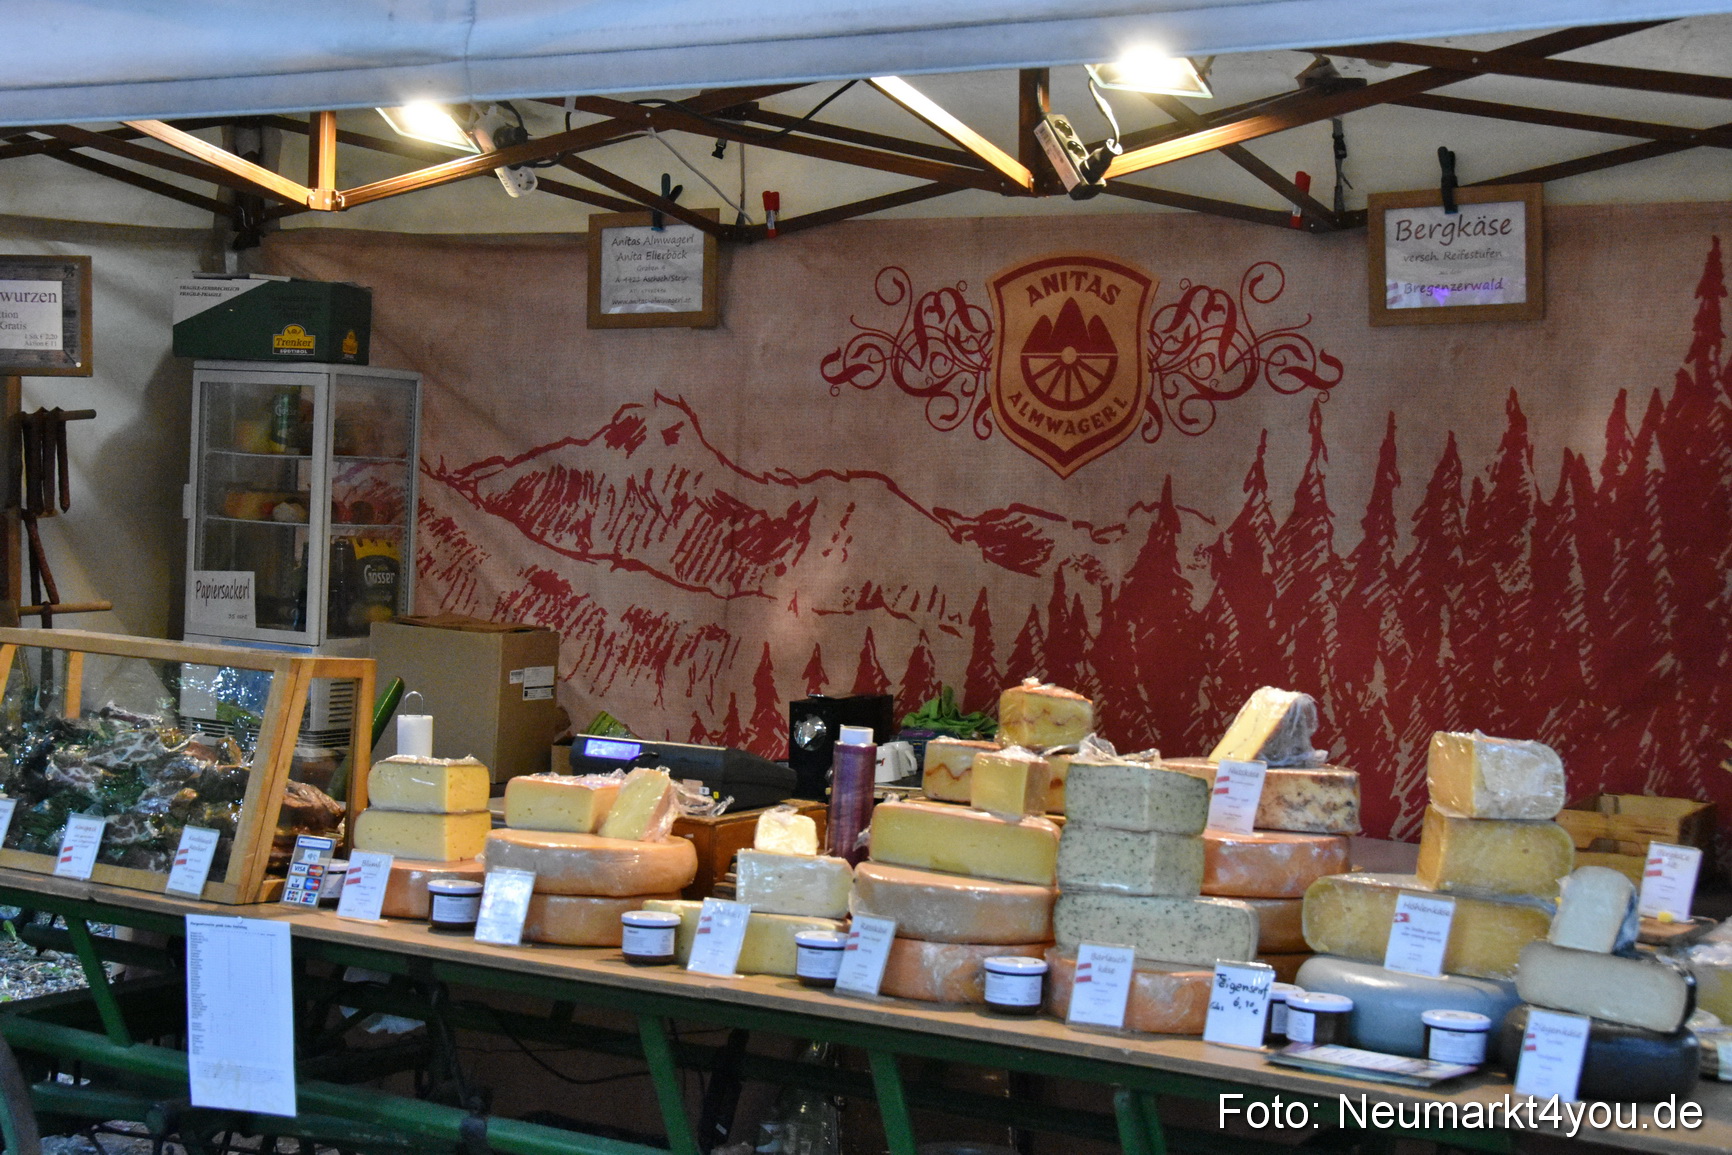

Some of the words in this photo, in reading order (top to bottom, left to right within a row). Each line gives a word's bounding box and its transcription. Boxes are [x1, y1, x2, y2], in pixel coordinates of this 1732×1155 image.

[1396, 214, 1513, 246] Bergkäse
[611, 236, 641, 247] Anitas
[643, 233, 695, 248] Almwagerl
[616, 251, 642, 262] Anita
[1404, 252, 1439, 263] versch.
[1443, 247, 1503, 261] Reifestufen
[1026, 270, 1122, 307] ANITAS
[1404, 277, 1504, 297] Bregenzerwald
[0, 320, 27, 330] Gratis
[275, 337, 313, 348] Trenker
[1007, 390, 1128, 436] ALMWAGERL
[195, 577, 251, 607] Papiersackerl
